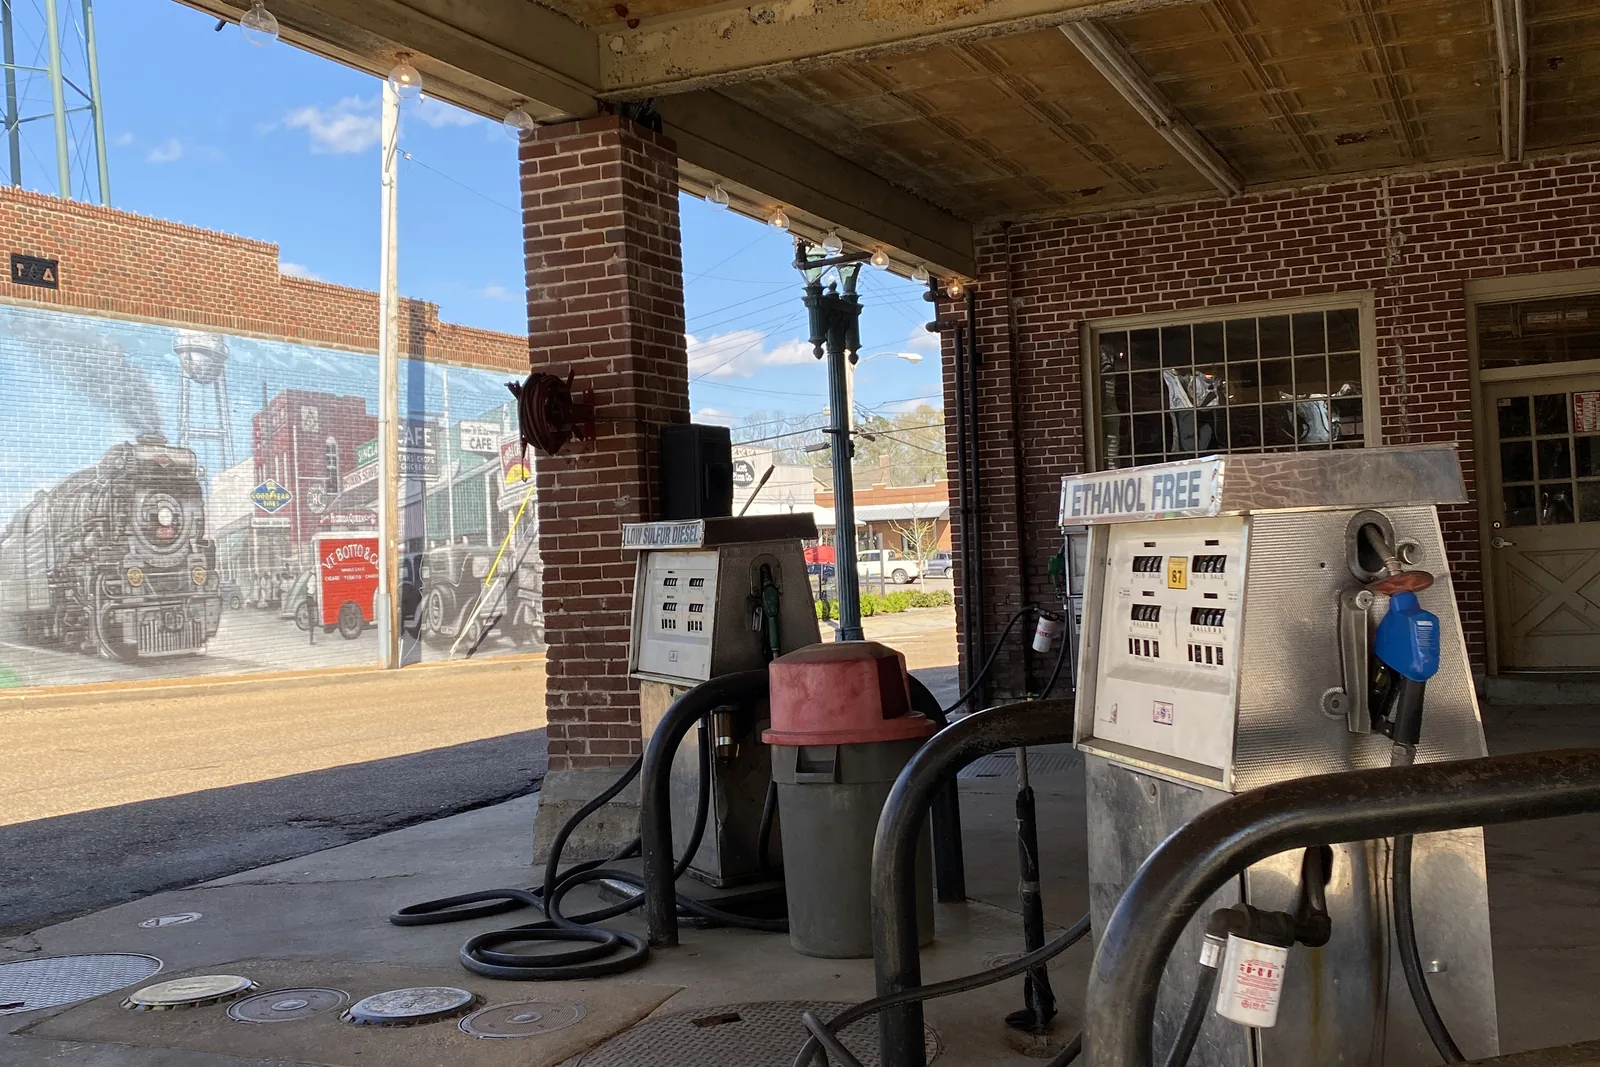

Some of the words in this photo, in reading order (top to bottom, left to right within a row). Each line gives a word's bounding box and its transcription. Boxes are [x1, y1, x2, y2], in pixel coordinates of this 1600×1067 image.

[469, 437, 492, 450] CAFE
[251, 491, 289, 500] GOODYEAR
[1072, 477, 1146, 517] ETHANOL
[1151, 470, 1201, 511] FREE
[626, 527, 643, 544] LOW
[643, 526, 671, 544] SULFUR
[671, 525, 698, 543] DIESEL
[335, 544, 363, 562] BOTTO
[364, 547, 370, 560] &
[1171, 570, 1182, 583] 87
